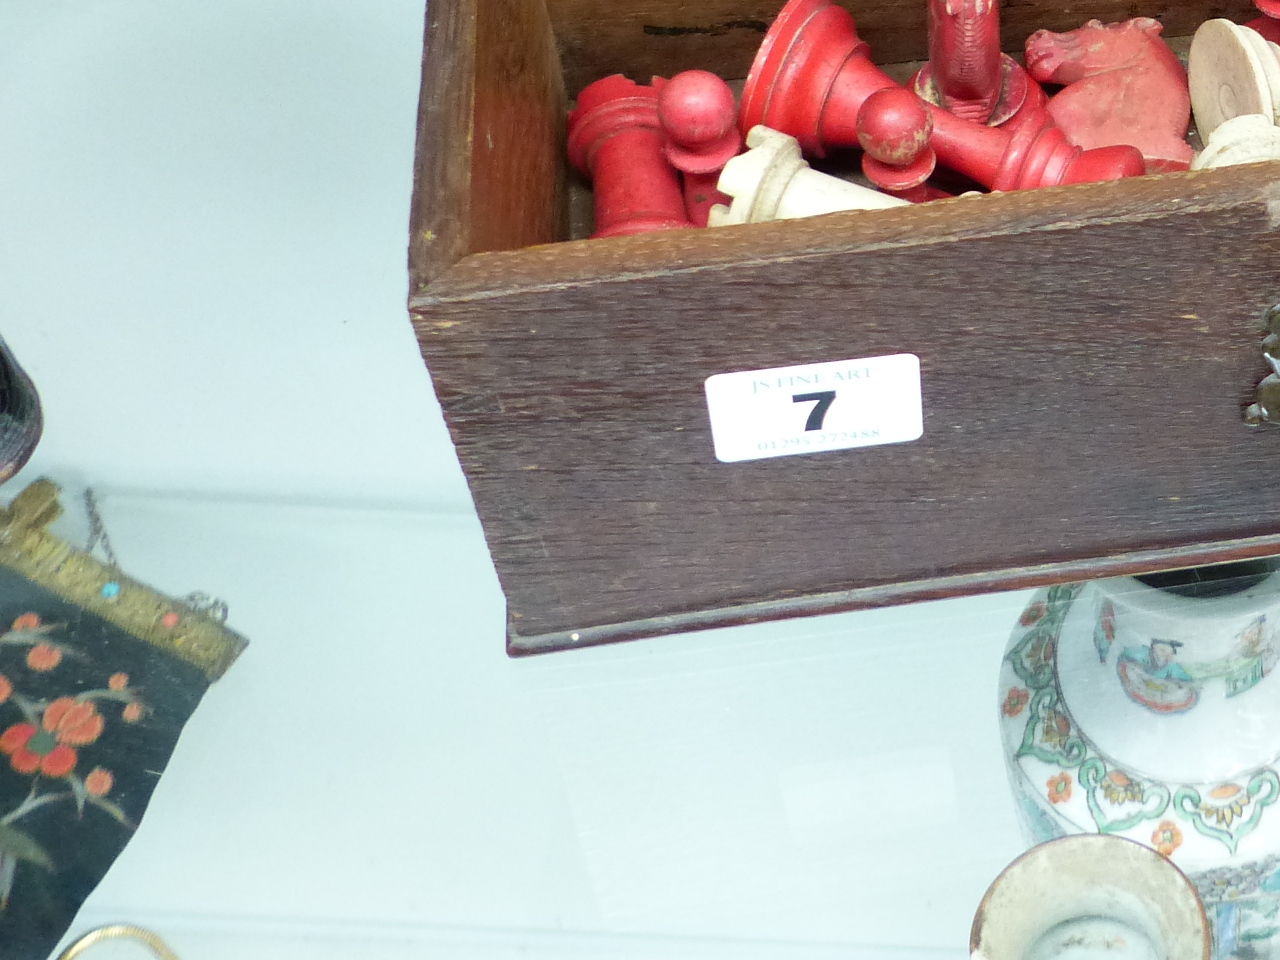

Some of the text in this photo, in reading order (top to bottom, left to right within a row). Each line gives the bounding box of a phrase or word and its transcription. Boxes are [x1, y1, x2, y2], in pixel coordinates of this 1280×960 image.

[750, 367, 874, 394] JS FINE ART
[791, 390, 838, 432] 7
[756, 428, 881, 451] 01295 272488
